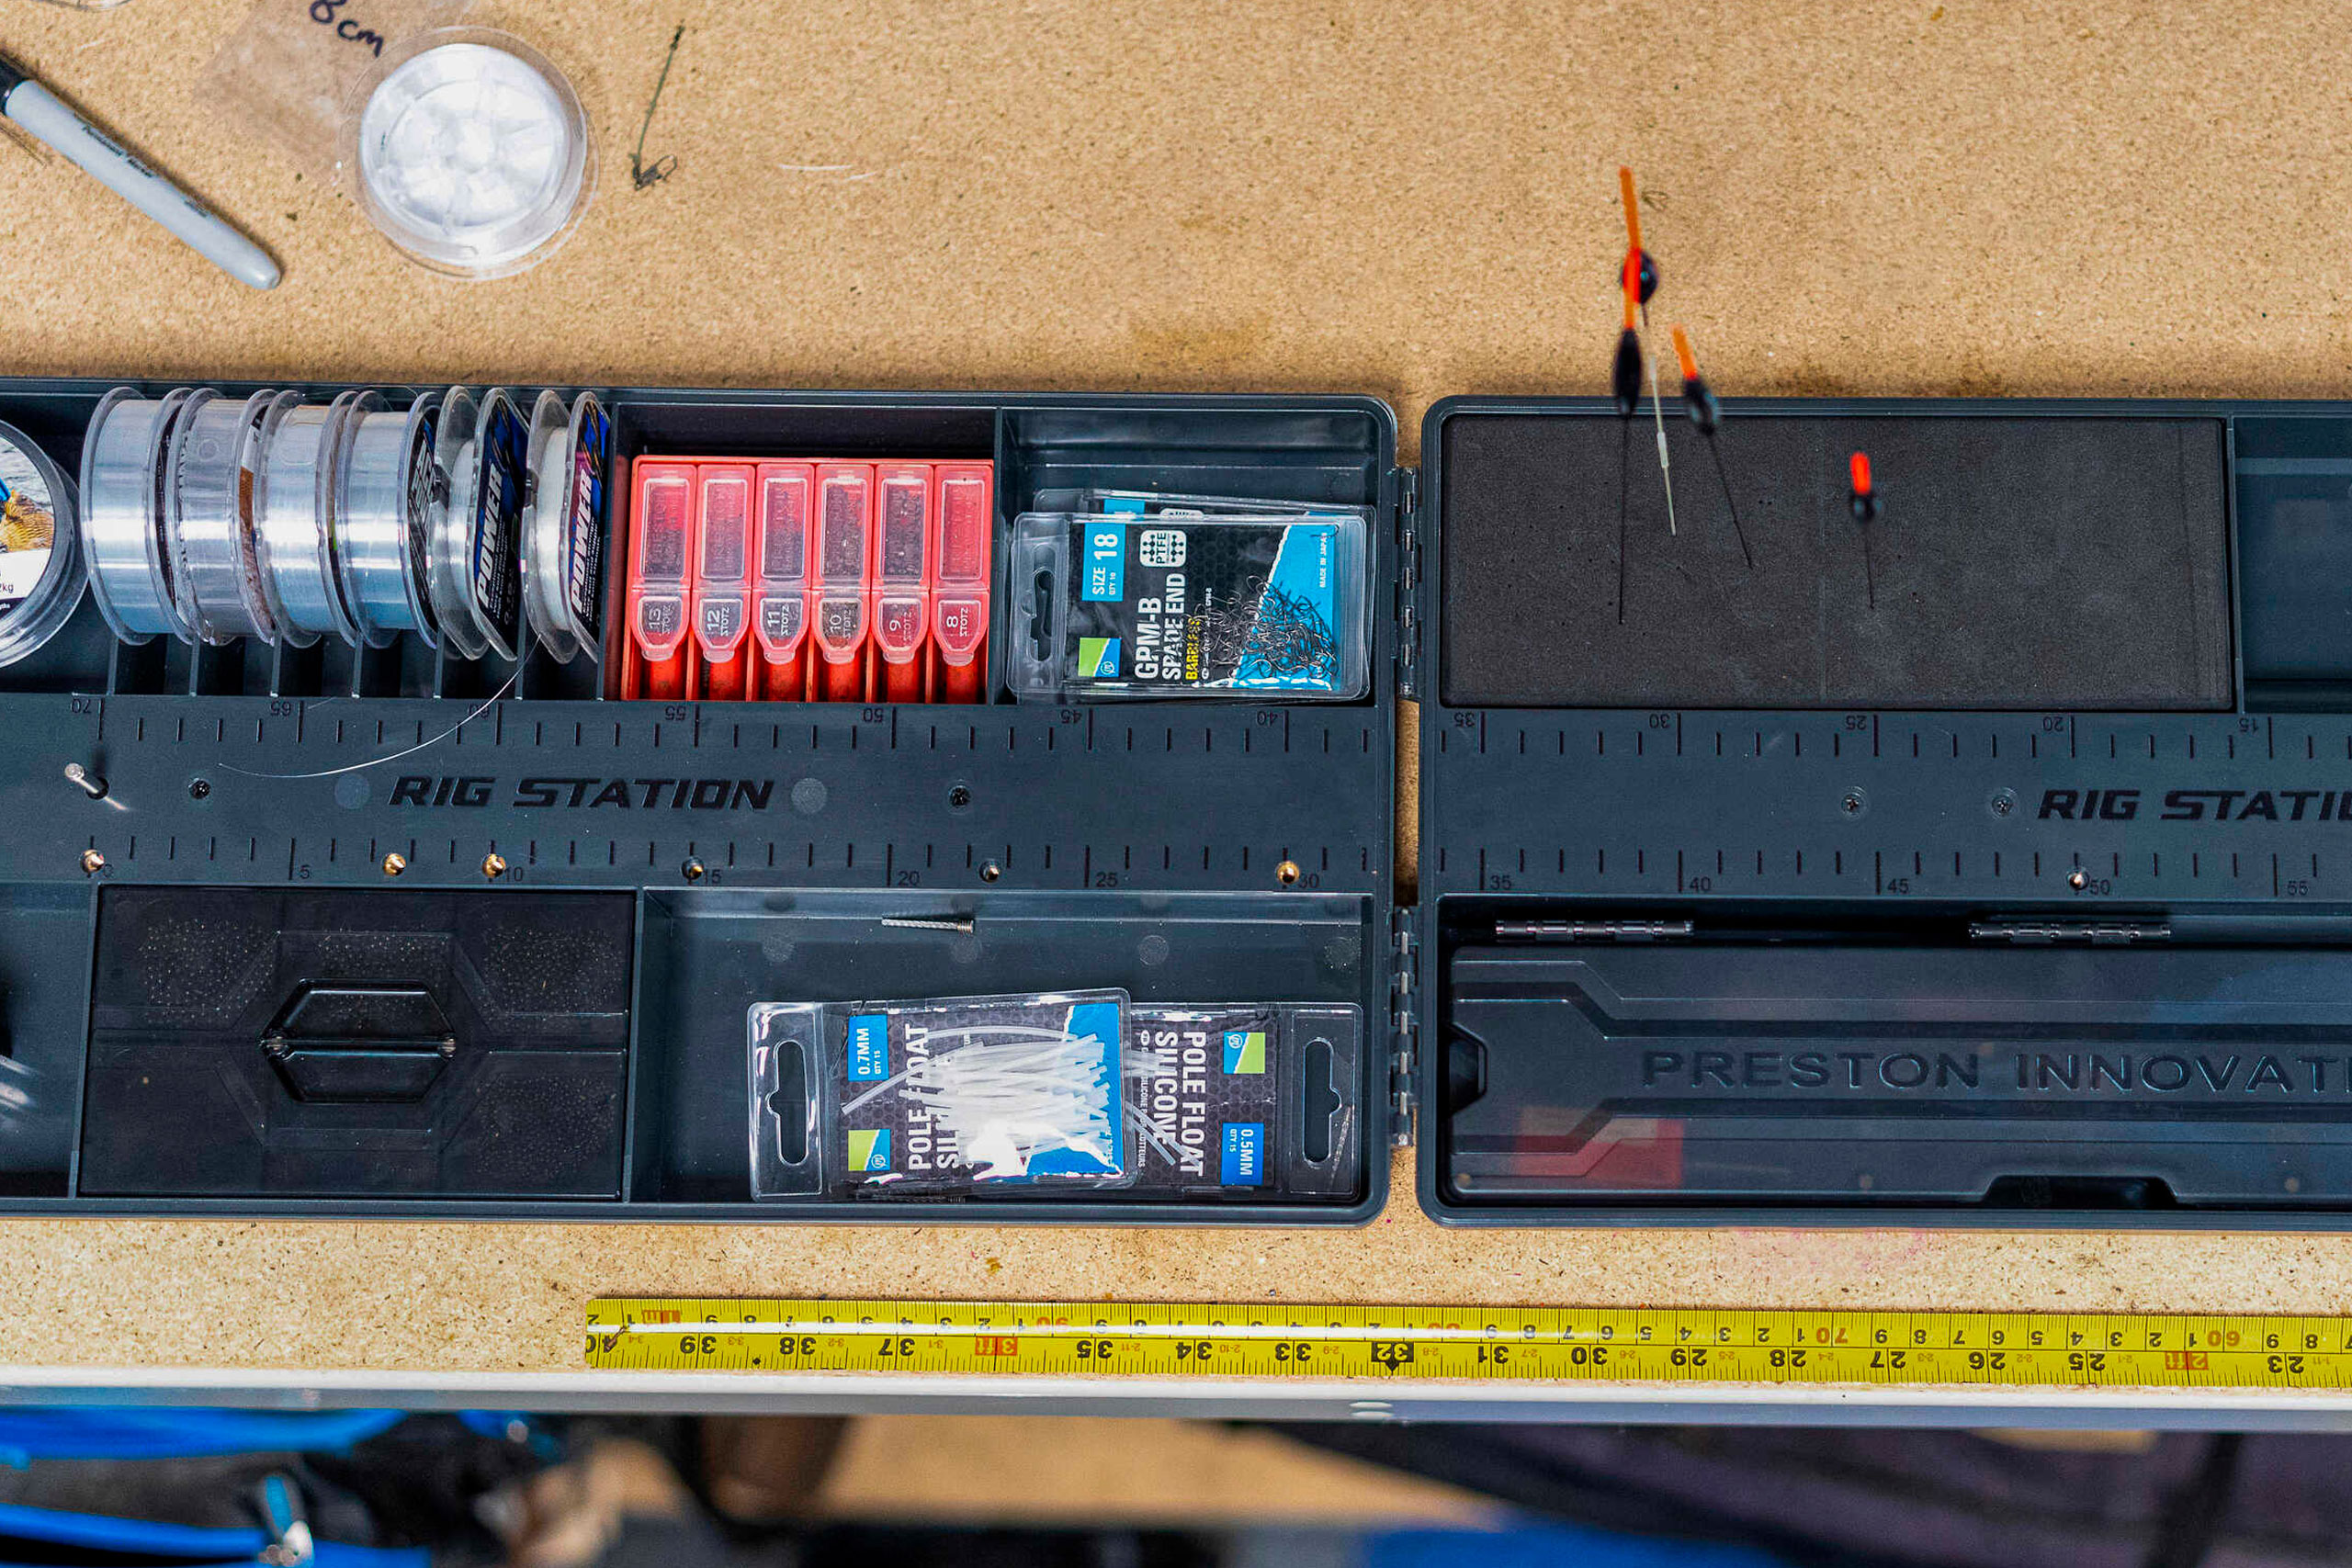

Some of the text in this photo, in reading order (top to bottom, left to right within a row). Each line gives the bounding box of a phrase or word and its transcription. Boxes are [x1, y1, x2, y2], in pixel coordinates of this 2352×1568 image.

[477, 463, 503, 608] POWER
[571, 468, 593, 614] POWER
[1157, 532, 1167, 564] PTFE
[1092, 534, 1118, 595] SIZE 18
[0, 582, 14, 593] kg
[707, 609, 720, 631] 12
[767, 611, 780, 627] 11
[781, 604, 789, 637] STOTZ
[830, 615, 842, 633] 10
[946, 615, 958, 628] 8
[960, 607, 968, 637] STOTZ
[1161, 573, 1185, 681] SPADE END
[1134, 597, 1161, 679] GPM-B
[71, 700, 93, 715] 70
[270, 702, 291, 717] 65
[665, 705, 686, 721] 55
[863, 707, 884, 723] 50
[1060, 709, 1081, 724] 45
[1257, 710, 1278, 724] 40
[1453, 713, 2258, 733] 35 30 25 20 15
[389, 776, 775, 809] RIG STATION
[2037, 789, 2141, 820] RIG
[300, 864, 311, 880] 5
[503, 866, 524, 882] 10
[704, 869, 722, 885] 15
[898, 871, 920, 886] 20
[1096, 872, 1118, 887] 25
[1298, 874, 1319, 889] 30
[1489, 875, 2309, 896] 35 40 45 50 55
[856, 1028, 871, 1075] 0.7MM
[874, 1050, 882, 1075] QTY 15
[1643, 1052, 1980, 1089] PRESTON
[1180, 1032, 1206, 1177] POLE FLOAT
[908, 1107, 932, 1170] POLE
[1137, 1130, 1146, 1168] LOTTEURS
[1229, 1144, 1237, 1153] 15
[1240, 1128, 1253, 1176] 0.5MM
[1485, 1324, 1498, 1339] 9
[1523, 1325, 1537, 1339] 8
[1563, 1325, 1575, 1340] 7
[1600, 1325, 1613, 1340] 6
[1640, 1325, 1652, 1341] 5
[1679, 1326, 1692, 1341] 4
[1718, 1326, 1731, 1342] 3
[1758, 1327, 1770, 1343] 2
[1797, 1327, 1804, 1342] 1
[1815, 1327, 1848, 1344] 70
[1874, 1329, 1888, 1344] 9
[1914, 1329, 1927, 1344] 8
[1953, 1329, 1966, 1345] 7
[1992, 1330, 2005, 1345] 6
[2030, 1330, 2044, 1346] 5
[2070, 1331, 2084, 1346] 4
[2110, 1332, 2123, 1347] 3
[2149, 1332, 2162, 1348] 2
[2188, 1332, 2197, 1348] 1
[2207, 1331, 2240, 1347] 60
[2267, 1333, 2279, 1348] 9
[2304, 1333, 2318, 1348] 8
[680, 1336, 717, 1354] 39
[728, 1336, 744, 1346] 3-3
[780, 1337, 816, 1355] 38
[827, 1337, 845, 1347] 3-2
[878, 1337, 915, 1356] 37
[927, 1338, 944, 1348] 3-1
[1077, 1339, 1114, 1359] 35
[1219, 1343, 1240, 1353] 2-10
[1323, 1345, 1339, 1355] 2-9
[1176, 1341, 1213, 1360] 34
[1275, 1343, 1312, 1361] 33
[1376, 1343, 1408, 1361] 32
[1477, 1346, 1509, 1364] 31
[1571, 1347, 1608, 1365] 30
[1670, 1348, 1707, 1367] 29
[1770, 1349, 1806, 1368] 28
[1870, 1350, 1906, 1369] 27
[1969, 1351, 2006, 1370] 26
[2068, 1352, 2106, 1371] 25
[2267, 1355, 2305, 1374] 23
